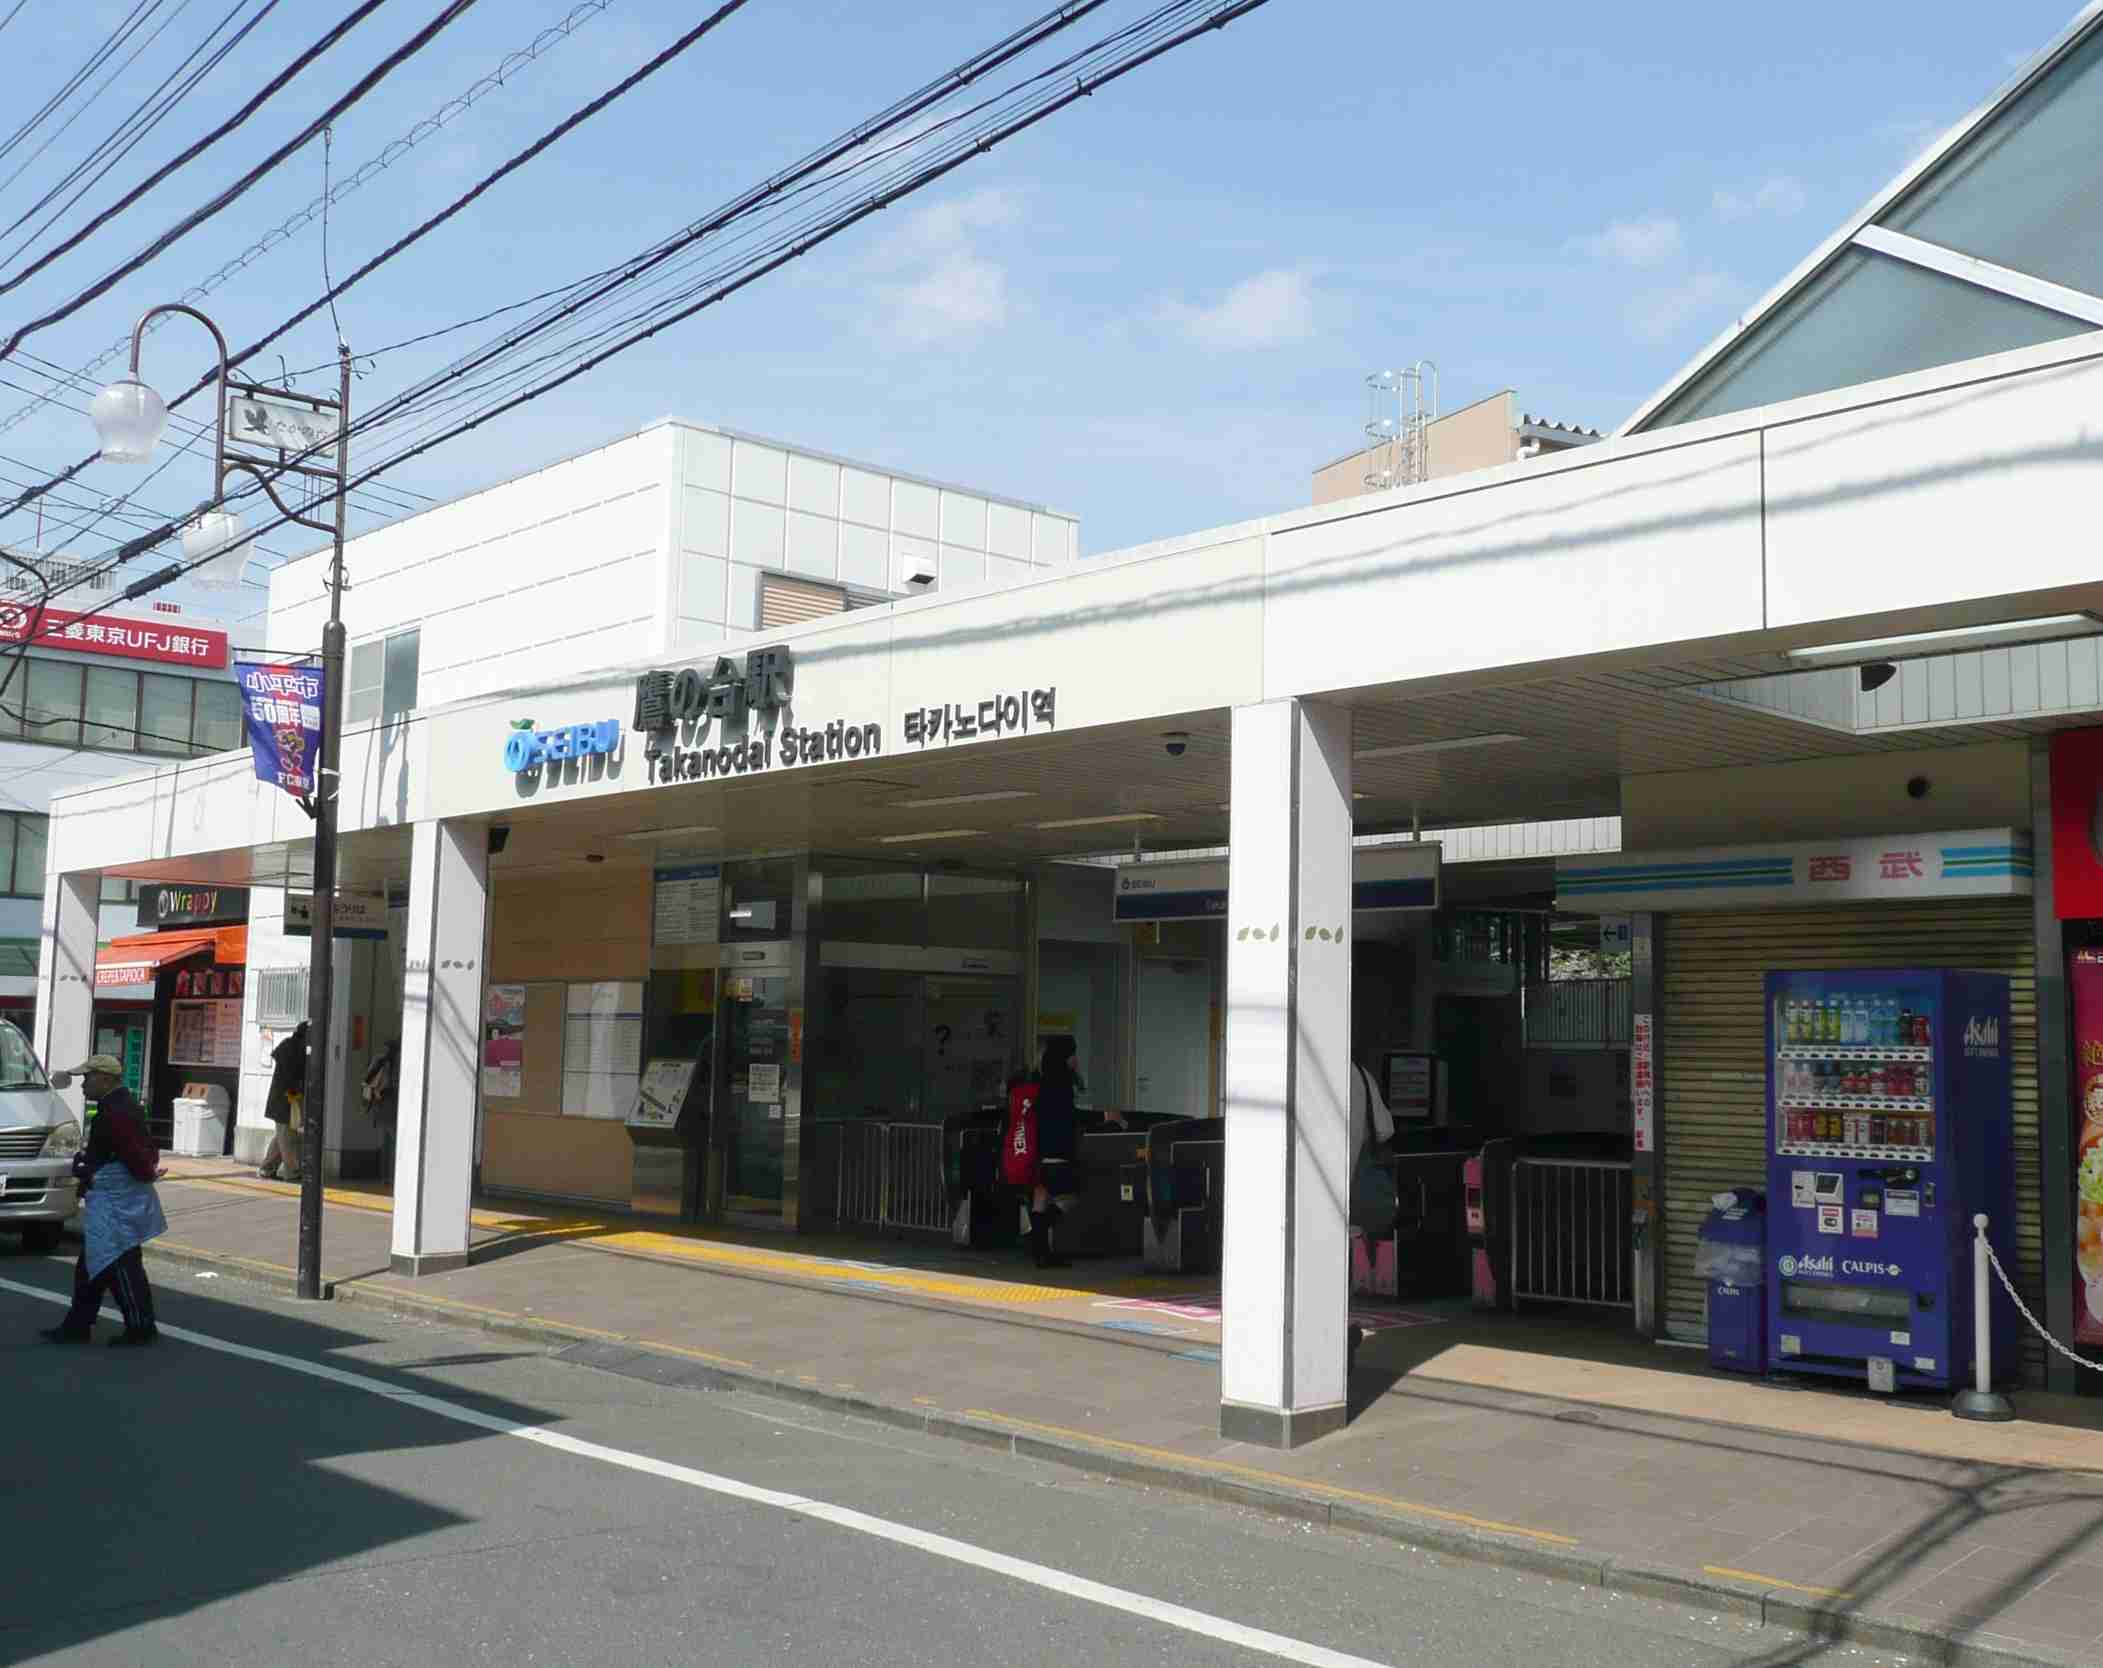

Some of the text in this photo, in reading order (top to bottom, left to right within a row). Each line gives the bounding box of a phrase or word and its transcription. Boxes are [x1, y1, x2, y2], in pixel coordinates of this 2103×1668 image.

[47, 618, 209, 657] 三菱東京UFJ銀行
[246, 671, 319, 699] 小平市
[632, 644, 796, 734] 鷹の台駅
[904, 687, 1056, 749] 타카노다이역
[644, 718, 882, 786] Takanodai Station
[1808, 850, 1924, 881] 西武
[170, 890, 218, 916] Wrappy
[1963, 1015, 1999, 1046] Asahi
[1798, 1254, 1834, 1272] Asahi
[1841, 1259, 1885, 1275] CALPIS
